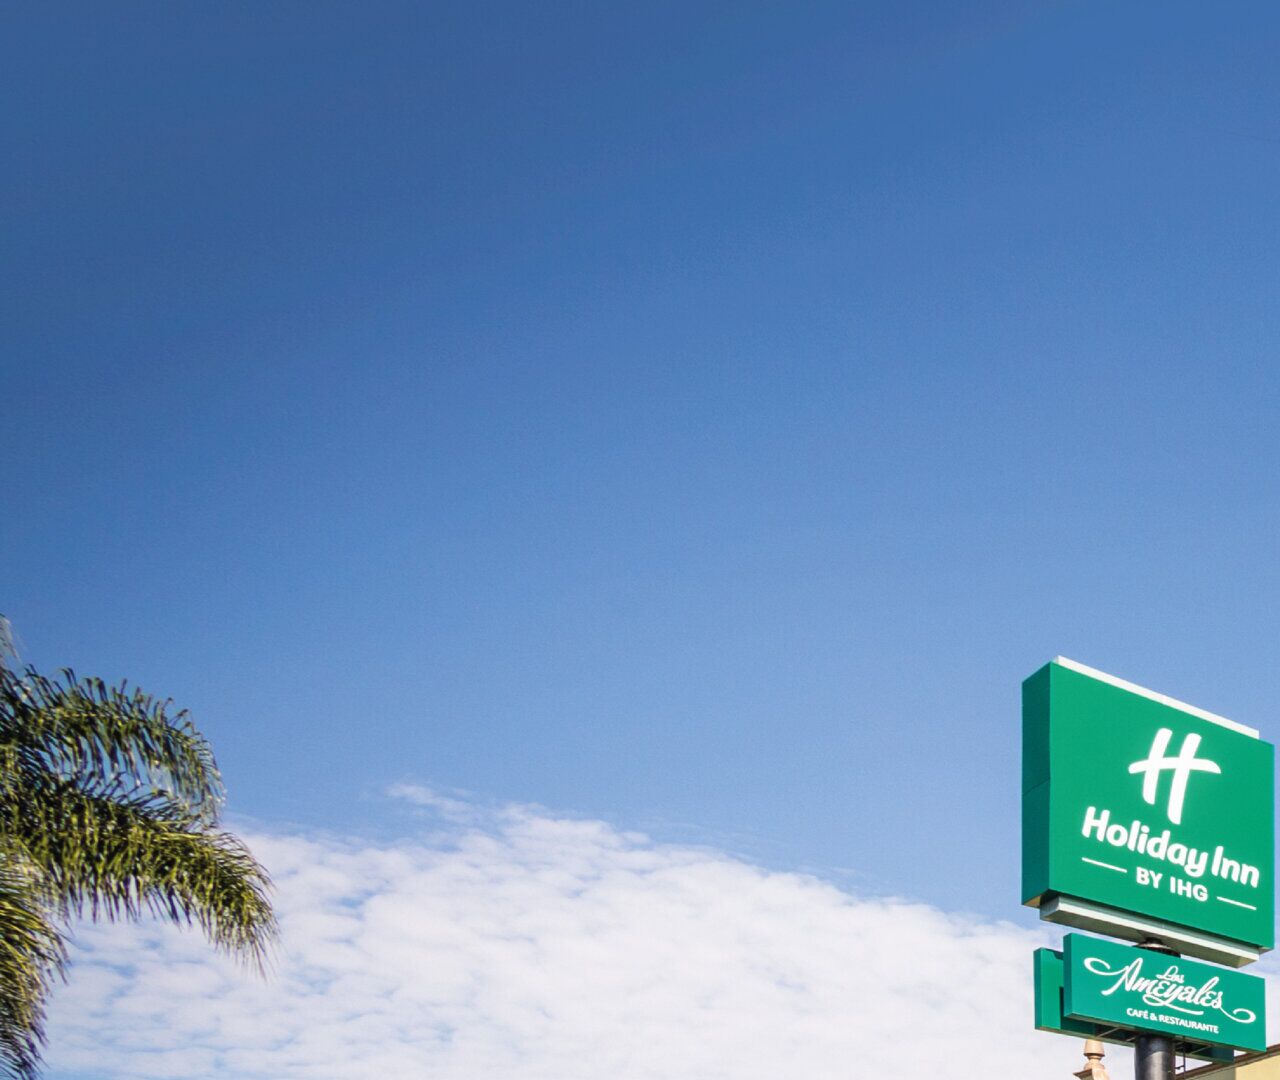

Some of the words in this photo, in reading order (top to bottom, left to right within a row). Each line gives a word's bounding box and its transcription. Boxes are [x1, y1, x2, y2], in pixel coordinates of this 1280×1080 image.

[1081, 806, 1209, 877] Holiday
[1211, 846, 1260, 888] Inn
[1136, 866, 1163, 889] BY
[1170, 876, 1208, 902] IHG
[1155, 965, 1185, 984] Los
[1126, 1007, 1149, 1020] CAFÉ
[1150, 1012, 1158, 1022] &
[1159, 1014, 1220, 1035] RESTAURANTE
